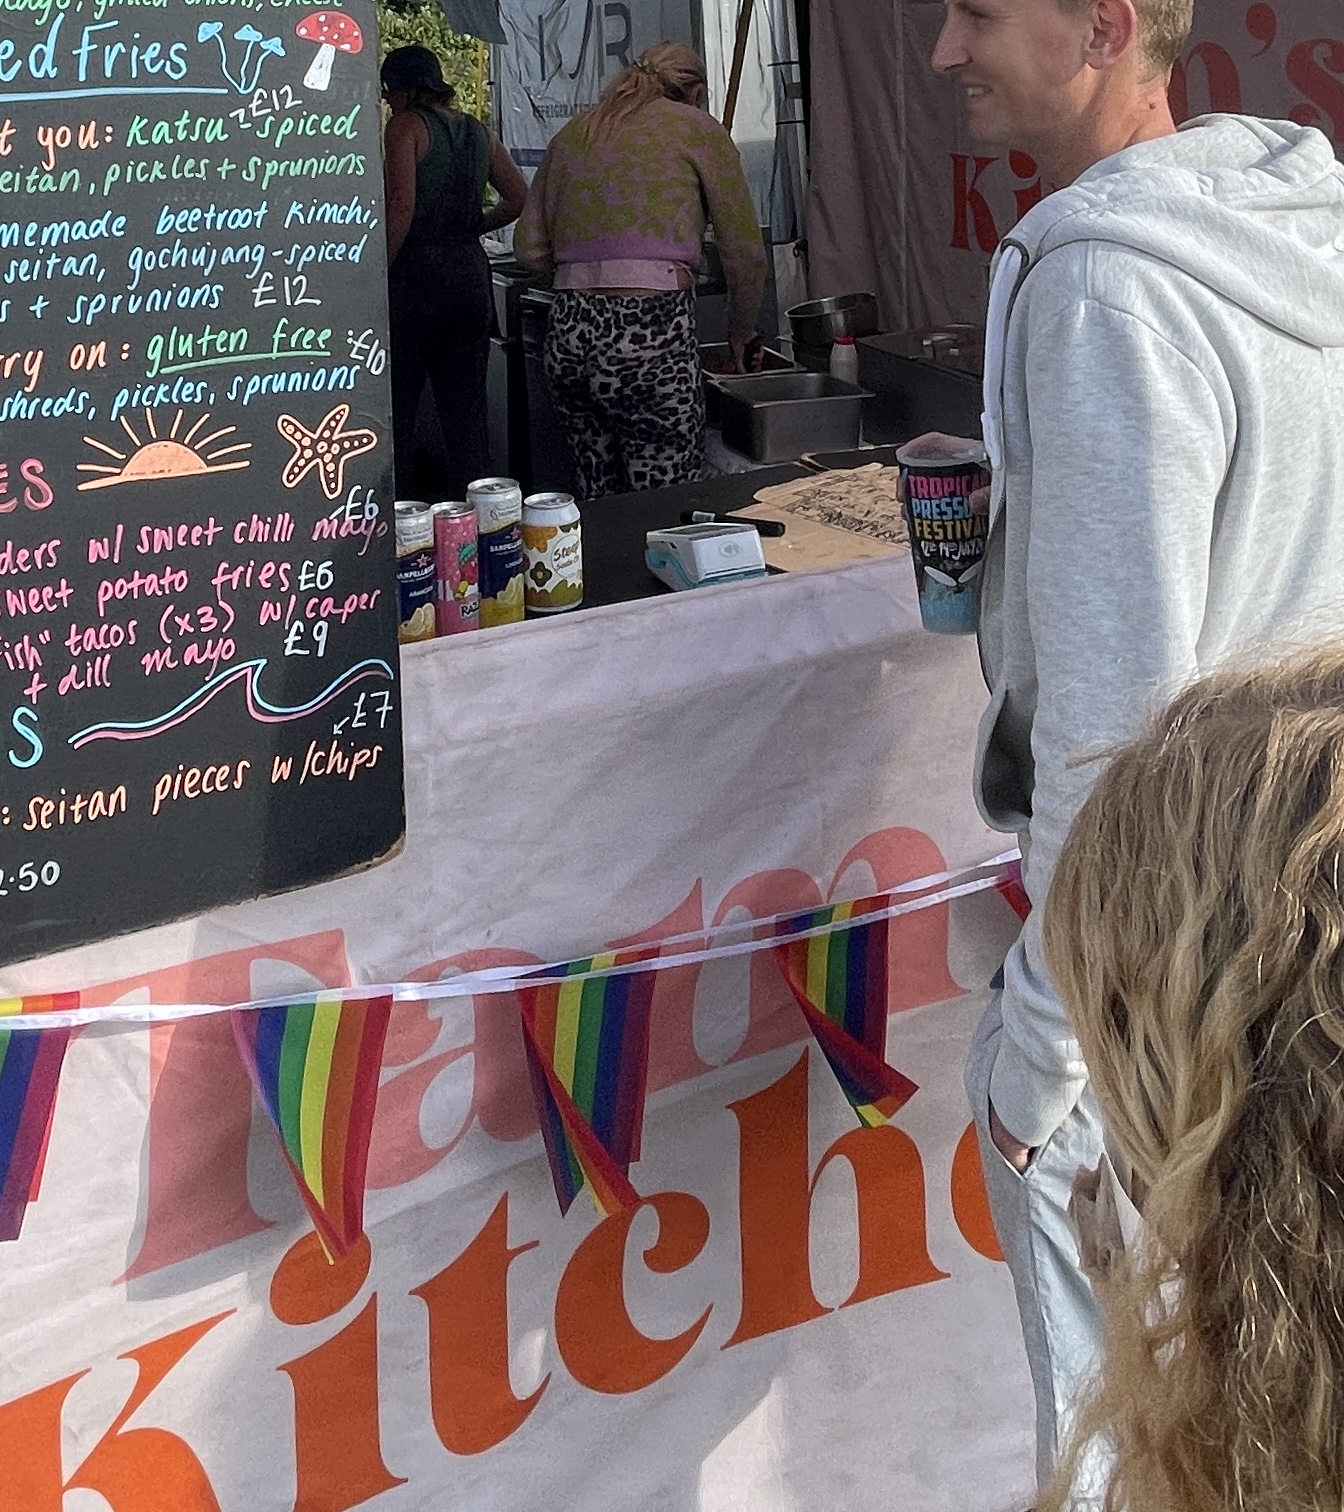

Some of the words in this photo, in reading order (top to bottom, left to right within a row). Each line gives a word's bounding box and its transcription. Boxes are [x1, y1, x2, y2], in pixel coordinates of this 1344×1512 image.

[104, 155, 209, 196] pickles
[156, 201, 268, 234] beetroot
[146, 325, 247, 378] gluten
[234, 513, 294, 543] chilli
[339, 485, 379, 528] £6
[911, 496, 973, 520] PRESSU
[312, 510, 387, 555] mayo
[98, 566, 188, 609] potato
[211, 560, 291, 598] fries
[298, 560, 333, 591] £6
[65, 620, 137, 656] tacos
[306, 590, 380, 623] caper
[58, 653, 111, 695] dill
[141, 638, 235, 681] mayo
[284, 620, 328, 657] £9
[23, 786, 126, 830] seitan
[153, 761, 250, 815] pieces
[352, 691, 392, 728] £7
